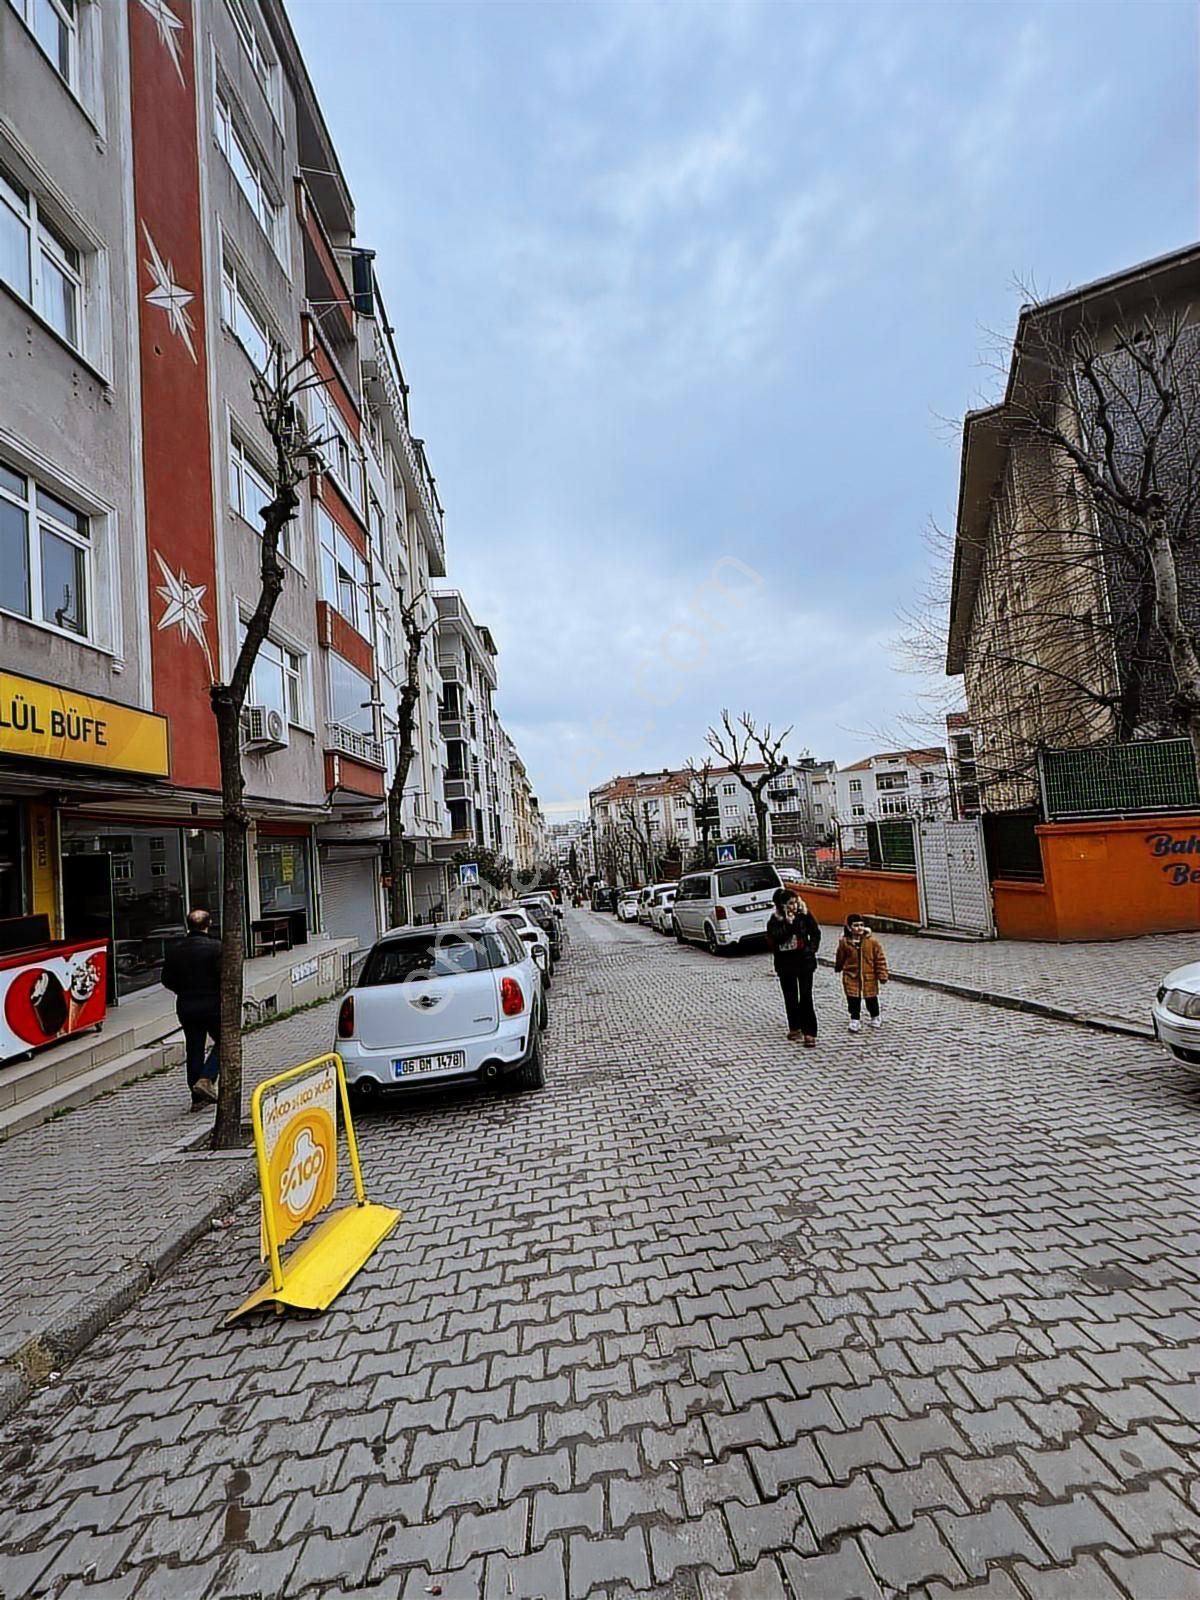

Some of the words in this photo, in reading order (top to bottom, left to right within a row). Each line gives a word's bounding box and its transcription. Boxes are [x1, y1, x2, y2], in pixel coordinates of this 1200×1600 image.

[51, 707, 107, 746] BÜFE
[437, 1054, 459, 1068] 1478
[282, 1150, 321, 1199] %100
